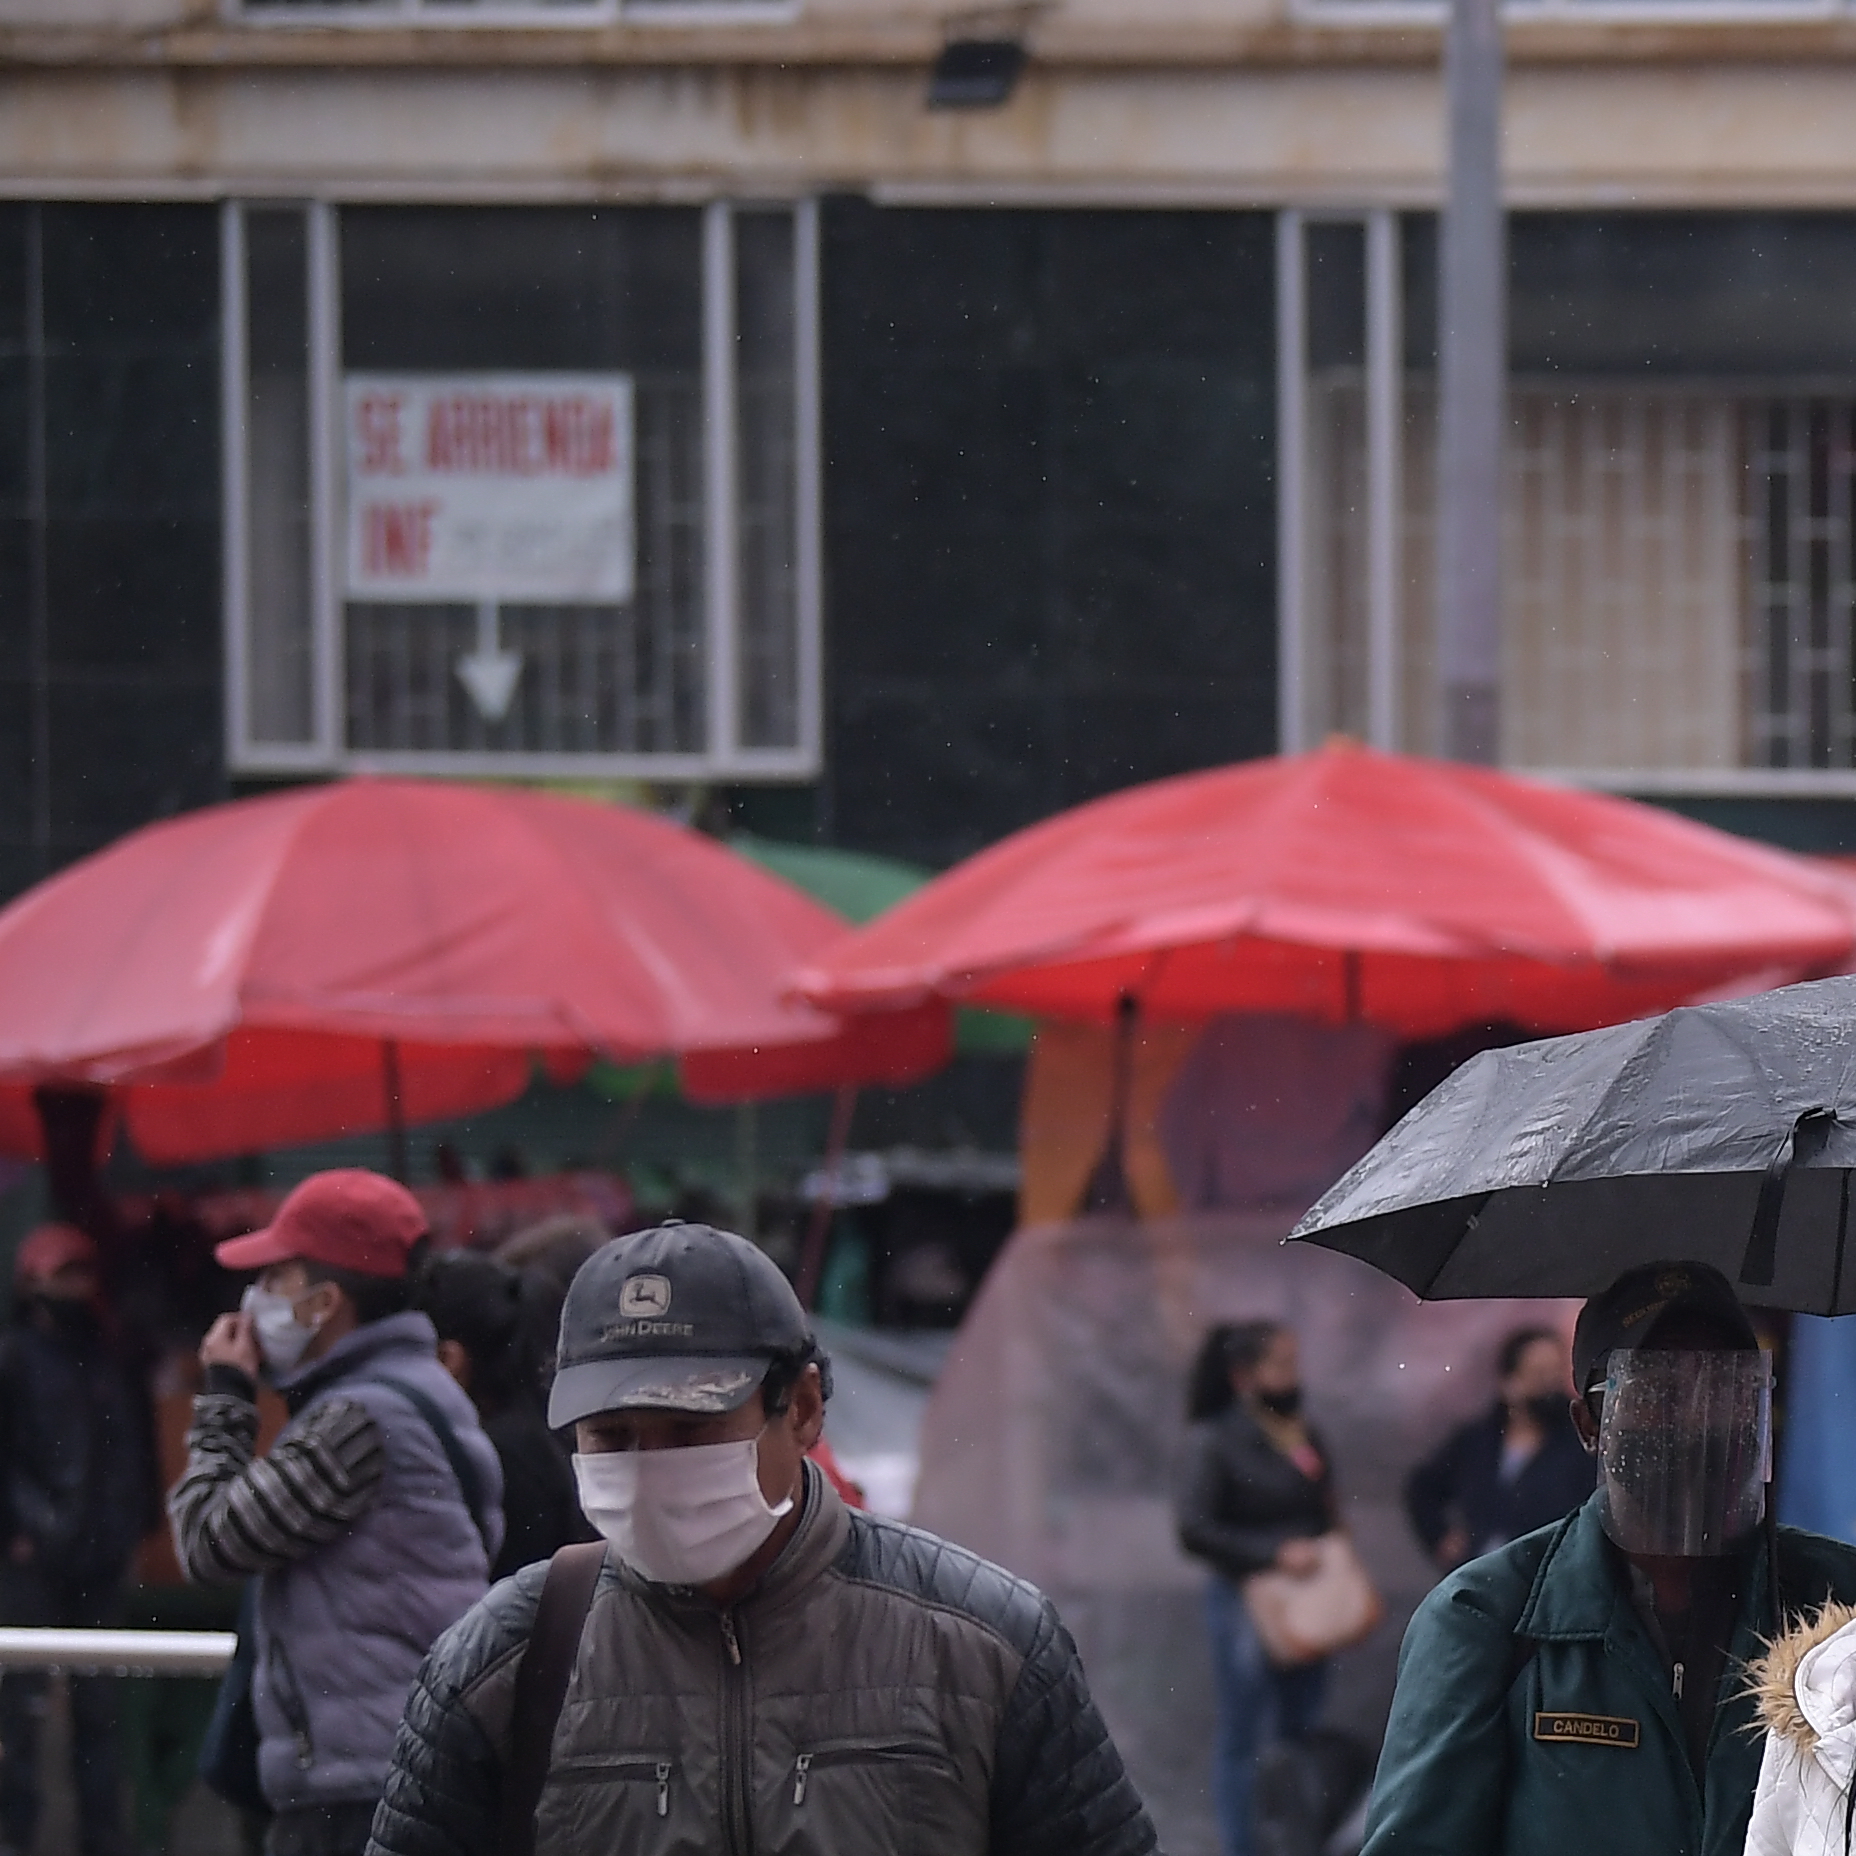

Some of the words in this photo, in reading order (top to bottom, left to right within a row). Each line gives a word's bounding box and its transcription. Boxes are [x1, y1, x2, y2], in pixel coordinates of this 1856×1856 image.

[358, 395, 406, 475] SE
[424, 395, 615, 477] ARRIENDA
[1553, 1720, 1619, 1738] CANDELO
